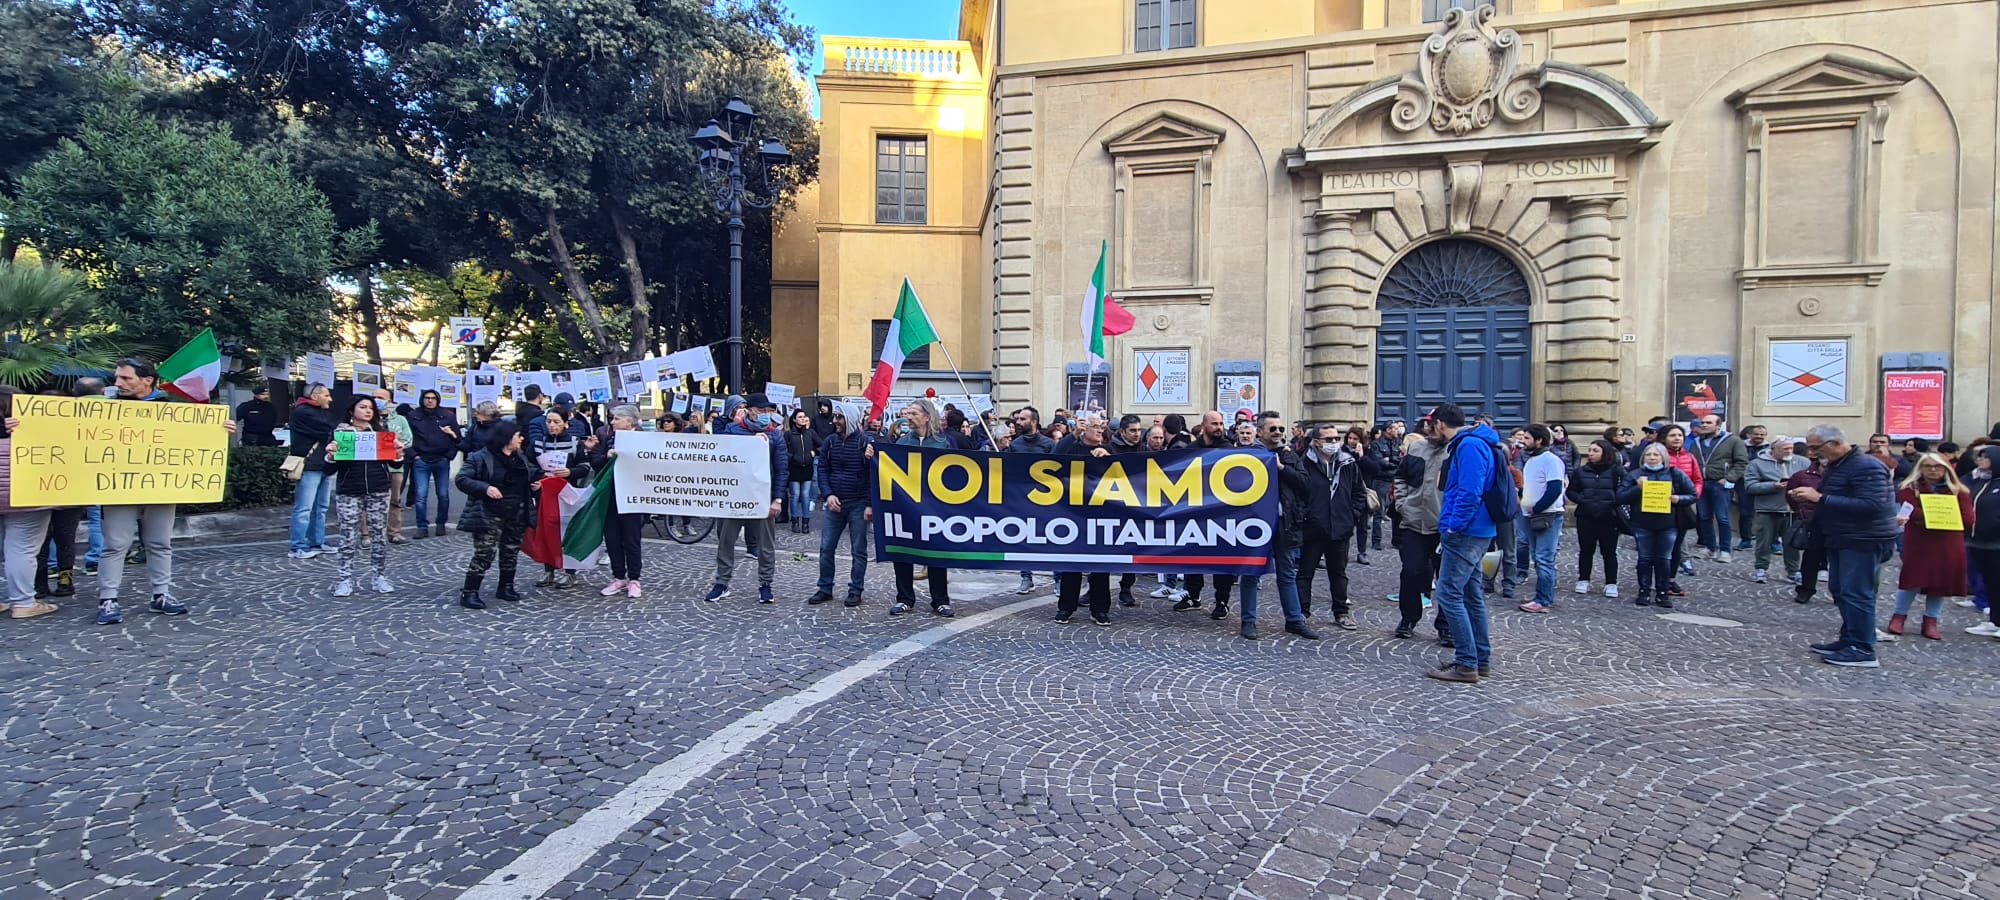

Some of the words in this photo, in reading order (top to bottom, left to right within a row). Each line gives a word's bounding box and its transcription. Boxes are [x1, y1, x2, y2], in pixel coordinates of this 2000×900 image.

[1326, 169, 1414, 190] TEATRO
[1516, 156, 1608, 179] ROSSINI
[16, 397, 122, 425] VACCINATI
[123, 407, 132, 418] E
[136, 407, 152, 419] NON
[155, 403, 229, 425] VACCINATI
[665, 441, 686, 449] NON
[688, 442, 718, 450] INIZIO'
[16, 446, 65, 465] PER
[85, 446, 115, 464] LA
[128, 447, 226, 466] LIBERTA'
[637, 451, 657, 460] CON
[659, 452, 669, 460] LE
[672, 452, 708, 462] CAMERE
[711, 454, 717, 462] A
[719, 454, 746, 464] GAS...
[39, 474, 68, 491] NO
[97, 468, 222, 491] DITTATURA
[643, 474, 674, 482] INIZIO'
[675, 475, 695, 484] CON
[701, 477, 739, 486] POLITICI
[878, 451, 1003, 504] NOI
[1027, 453, 1269, 507] SIAMO
[627, 496, 638, 504] LE
[640, 496, 681, 506] PERSONE
[653, 486, 671, 494] CHE
[673, 487, 729, 497] DIVIDEVANO
[884, 513, 913, 539] IL
[921, 515, 1079, 545] POPOLO
[1087, 518, 1273, 547] ITALIANO
